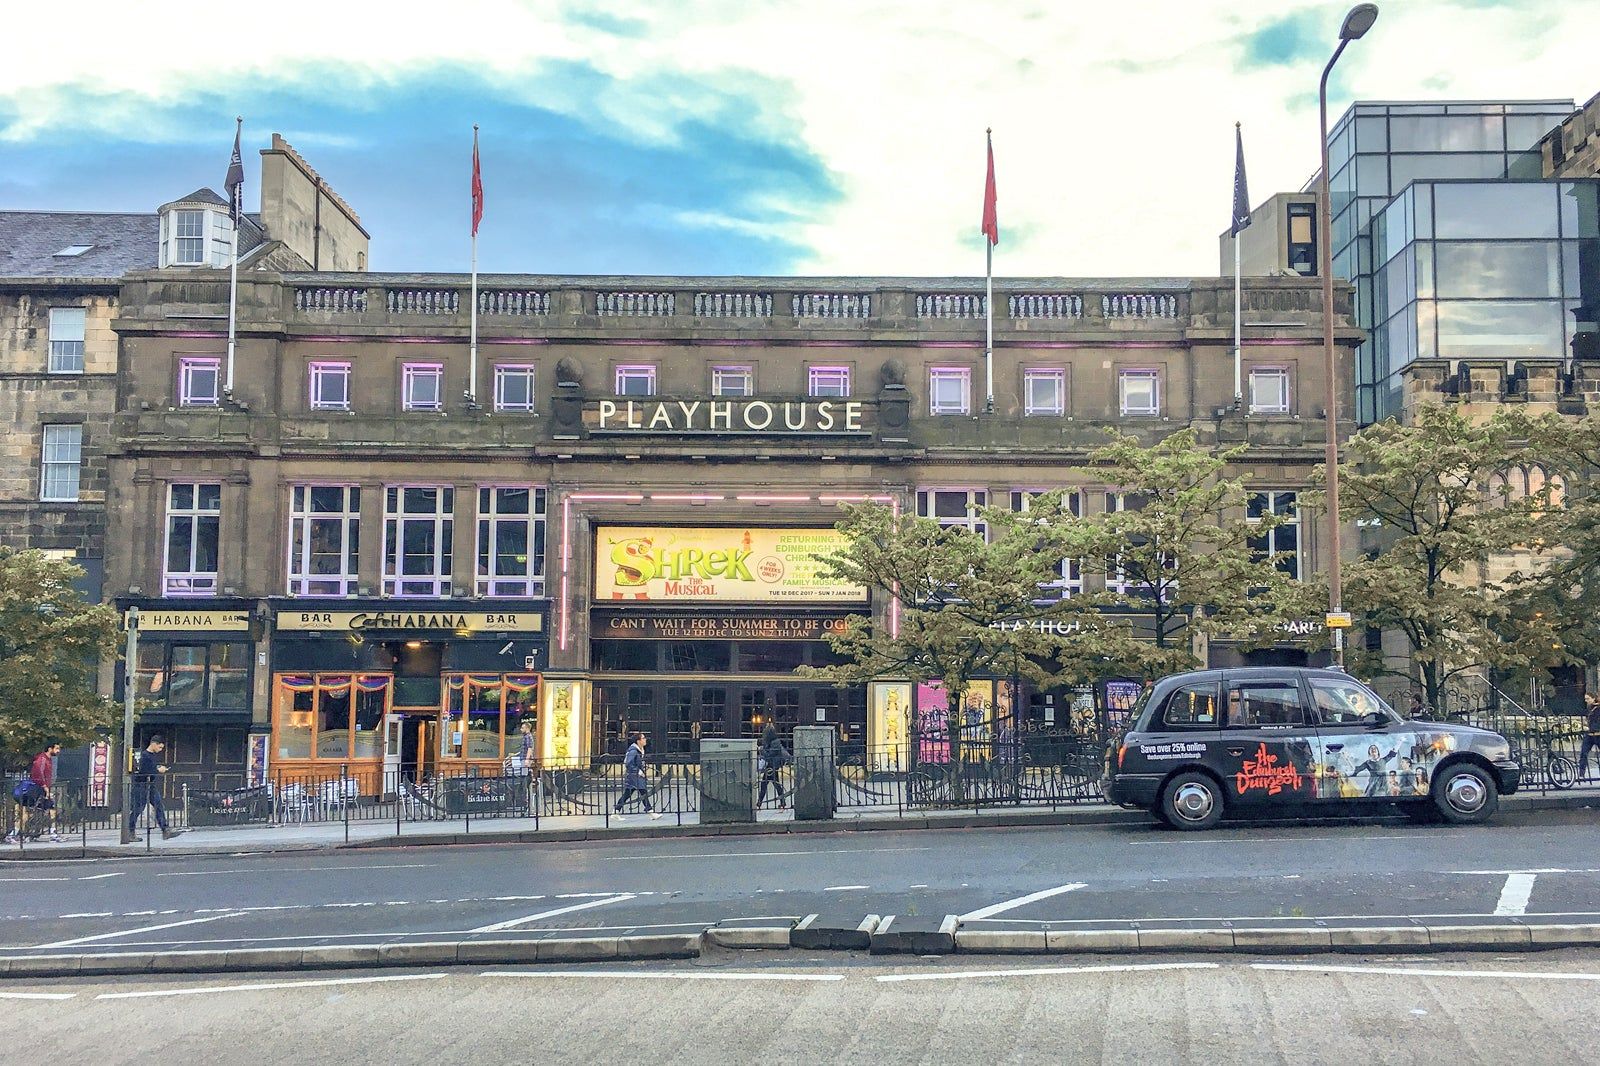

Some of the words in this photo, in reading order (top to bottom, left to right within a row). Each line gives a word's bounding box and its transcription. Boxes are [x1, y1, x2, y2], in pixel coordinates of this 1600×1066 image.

[599, 400, 862, 430] PLAYHOUSE
[779, 535, 835, 543] RETURNING
[775, 544, 832, 552] EDINBURGH
[153, 615, 212, 626] HABANA
[301, 613, 331, 623] BAR
[391, 614, 467, 628] HABANA
[486, 614, 516, 624] BAR
[610, 617, 646, 628] CANT
[653, 618, 686, 628] WAIT
[691, 618, 717, 629] FOR
[722, 618, 778, 629] SUMMER
[783, 619, 800, 629] TO
[804, 619, 819, 629] BE
[661, 628, 679, 636] TUE
[683, 628, 691, 636] 12
[731, 629, 742, 637] TO
[746, 629, 766, 637] SUN
[777, 629, 789, 637] TH
[792, 630, 809, 638] JAN
[1140, 744, 1156, 753] Save
[1171, 743, 1186, 752] 25%
[1186, 742, 1207, 752] online
[1254, 742, 1278, 765] the
[1243, 760, 1298, 777] Edinburgh
[1236, 771, 1302, 796] Dungeon
